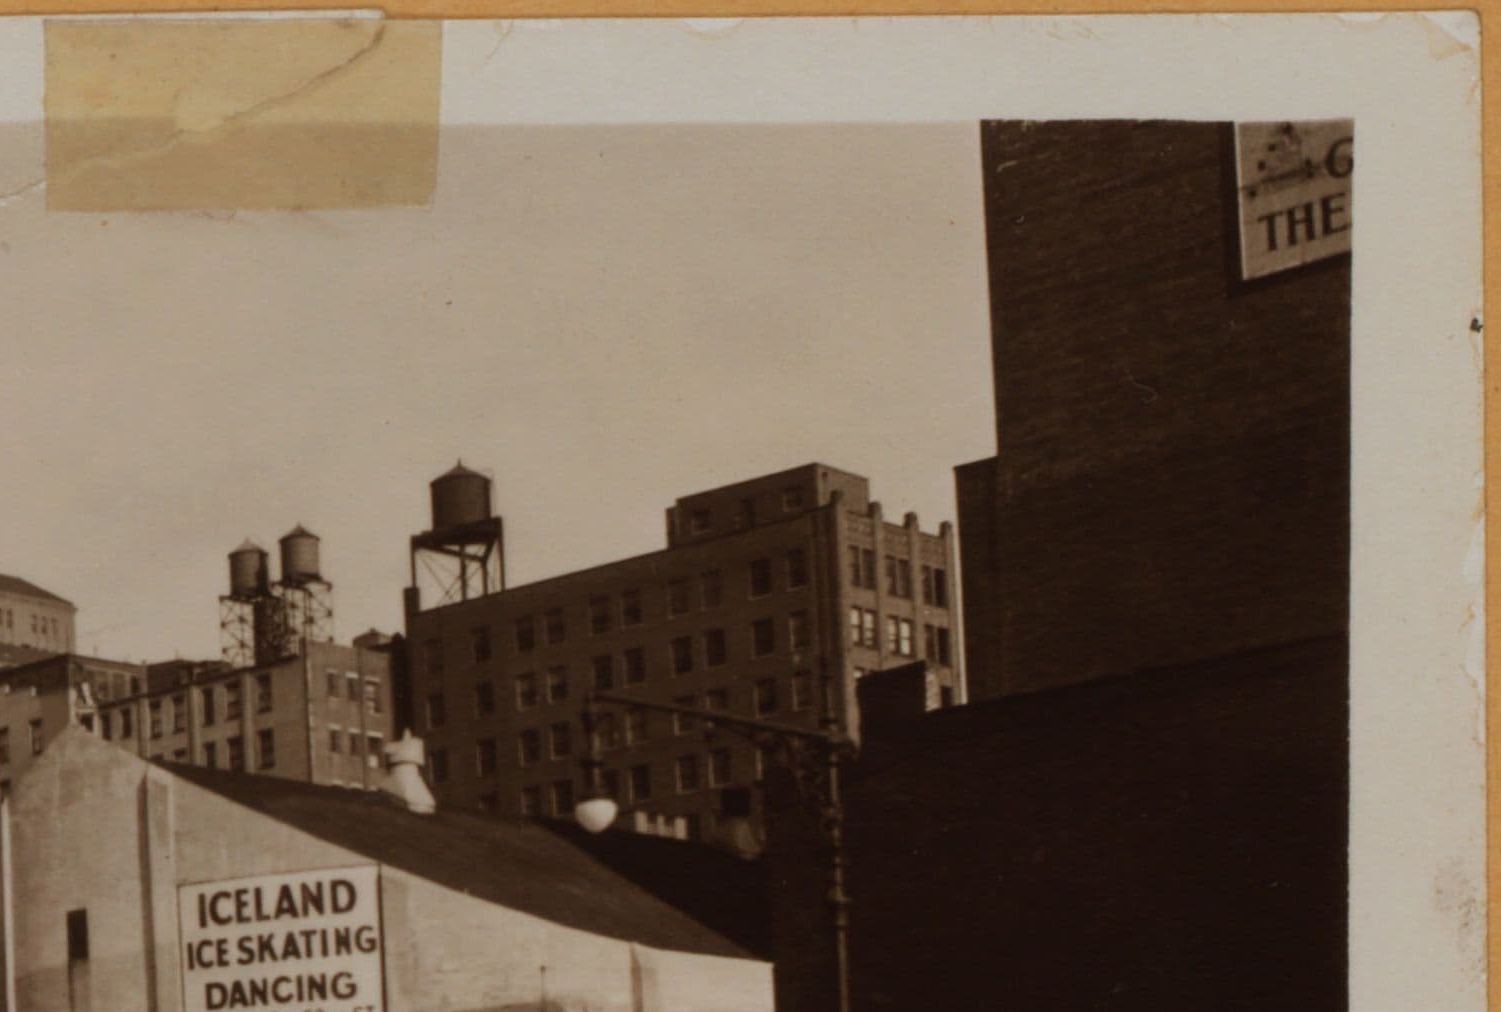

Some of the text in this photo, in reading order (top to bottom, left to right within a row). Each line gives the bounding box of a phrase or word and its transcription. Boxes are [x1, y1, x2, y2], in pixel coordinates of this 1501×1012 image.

[1257, 192, 1352, 252] THE
[197, 878, 357, 929] ICELAND
[186, 924, 378, 971] ICE SKATING
[204, 971, 358, 1011] DANCING
